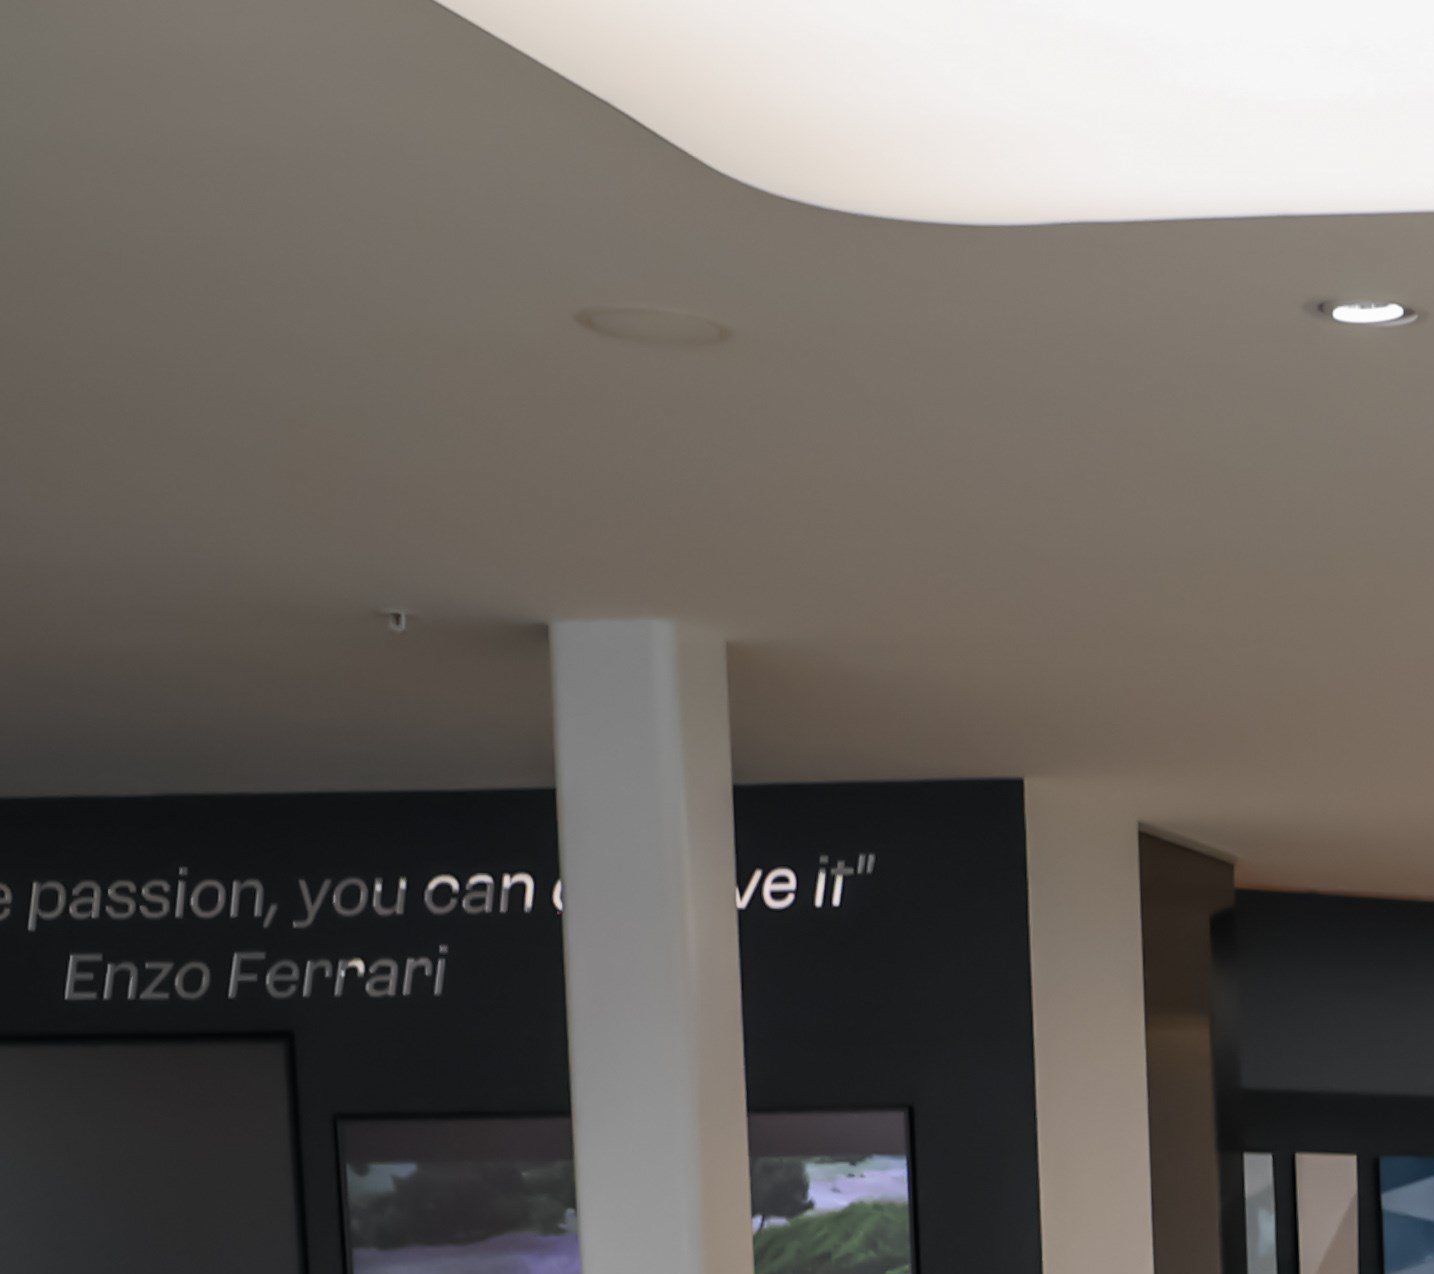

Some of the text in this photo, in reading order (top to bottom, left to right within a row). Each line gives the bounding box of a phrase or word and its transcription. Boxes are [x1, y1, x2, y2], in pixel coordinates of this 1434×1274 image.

[27, 865, 278, 932] passion,
[292, 876, 406, 930] you
[424, 872, 535, 915] can
[64, 944, 449, 1001] Enzo Ferrari
